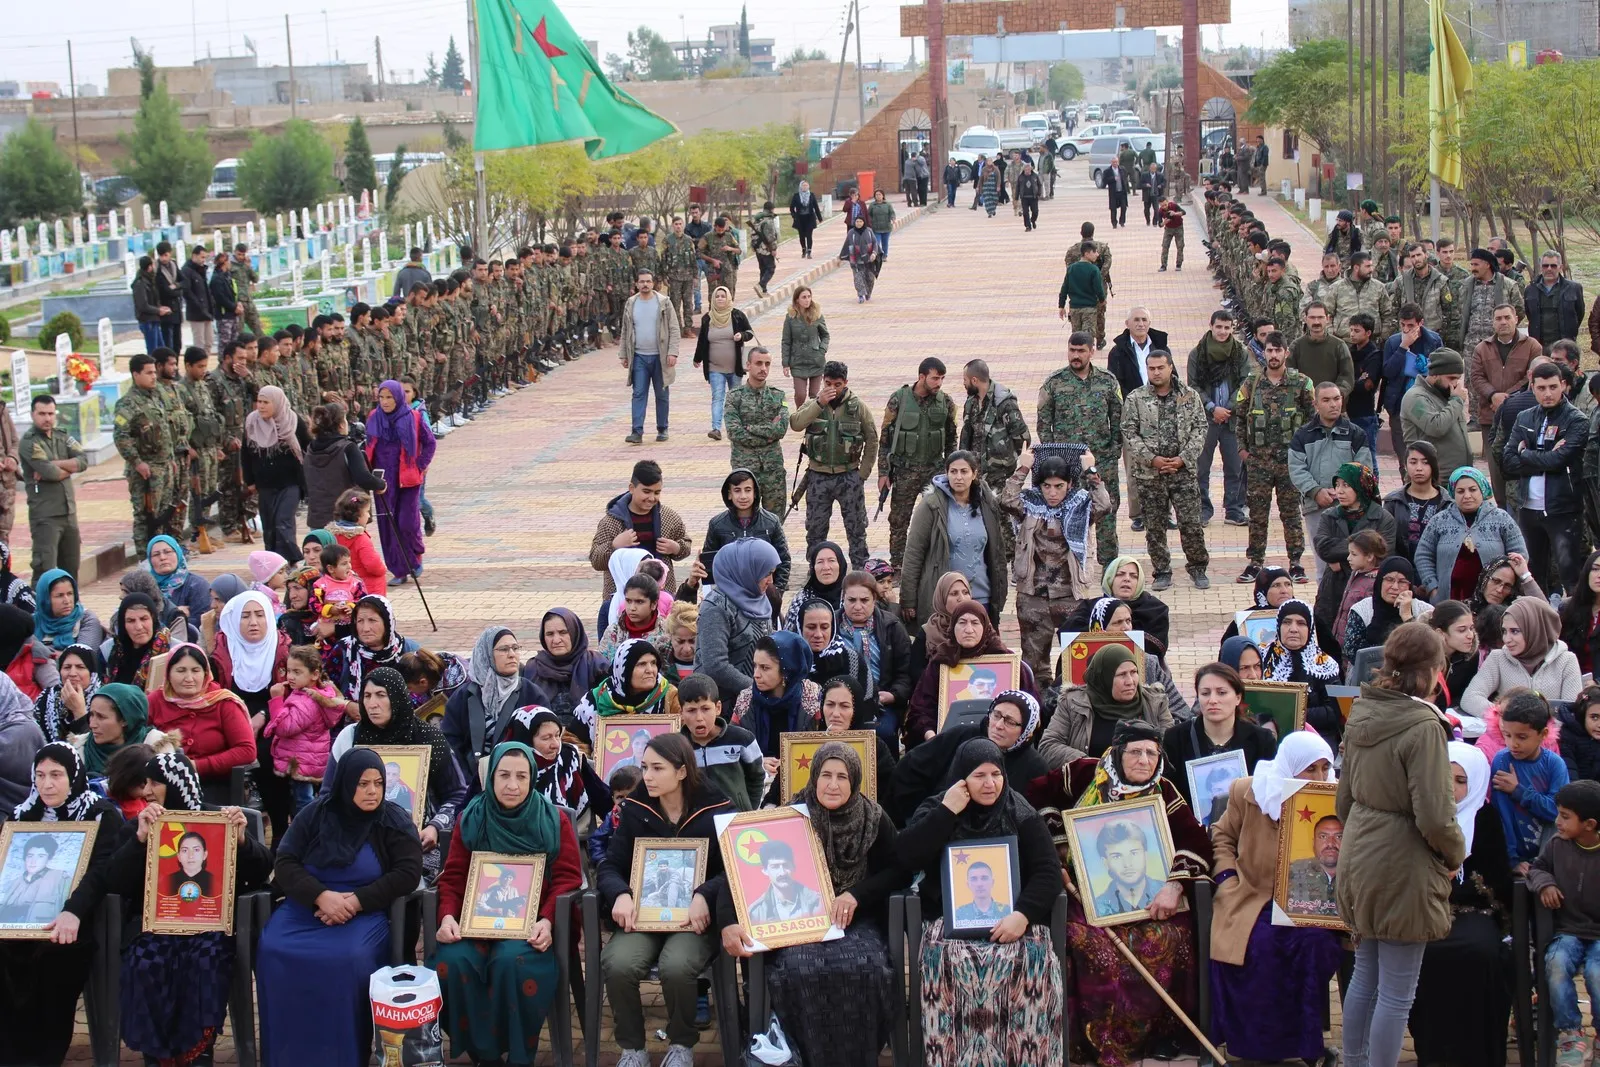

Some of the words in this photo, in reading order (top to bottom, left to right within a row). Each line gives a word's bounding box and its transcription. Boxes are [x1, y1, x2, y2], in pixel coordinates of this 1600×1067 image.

[755, 917, 826, 938] Ş.D.SASON
[375, 1004, 433, 1022] MAHMOOD
[418, 1013, 436, 1024] COFFEE
